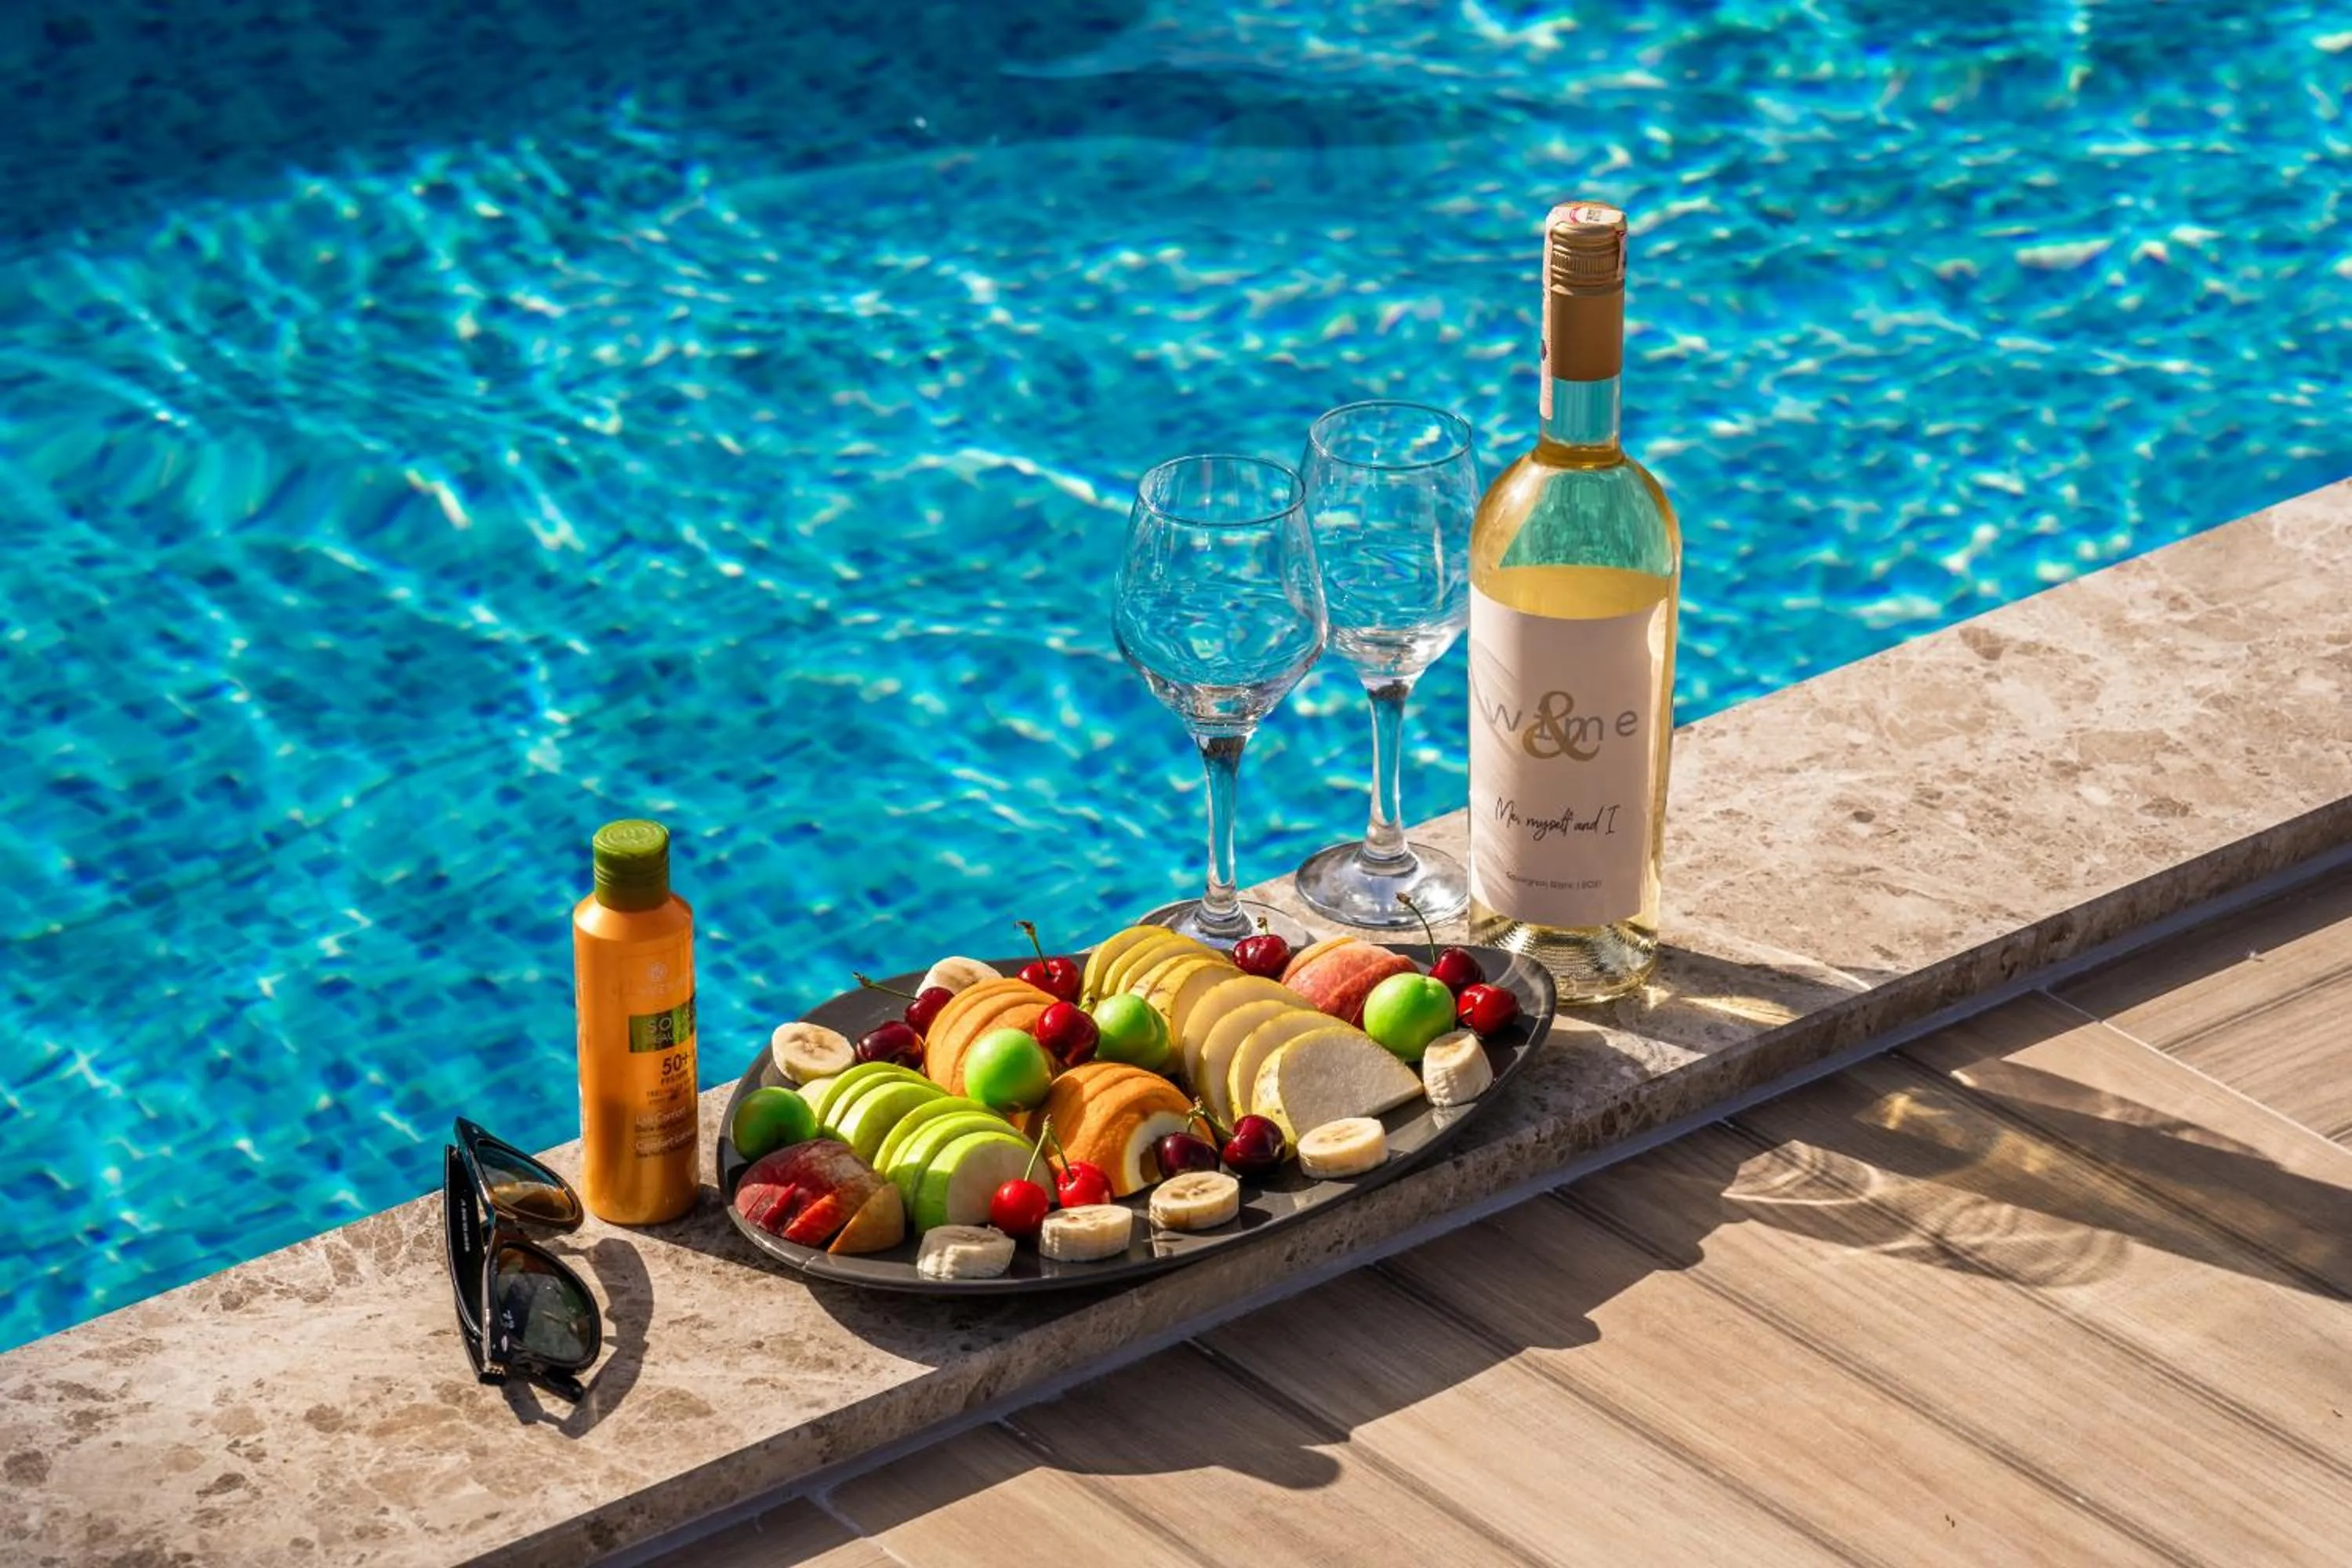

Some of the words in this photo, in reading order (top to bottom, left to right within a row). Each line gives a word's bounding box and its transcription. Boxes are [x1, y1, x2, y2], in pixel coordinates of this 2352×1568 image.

[1526, 808, 1573, 841] myself
[1573, 805, 1605, 833] and
[1606, 804, 1621, 835] I
[662, 1052, 689, 1076] 50+
